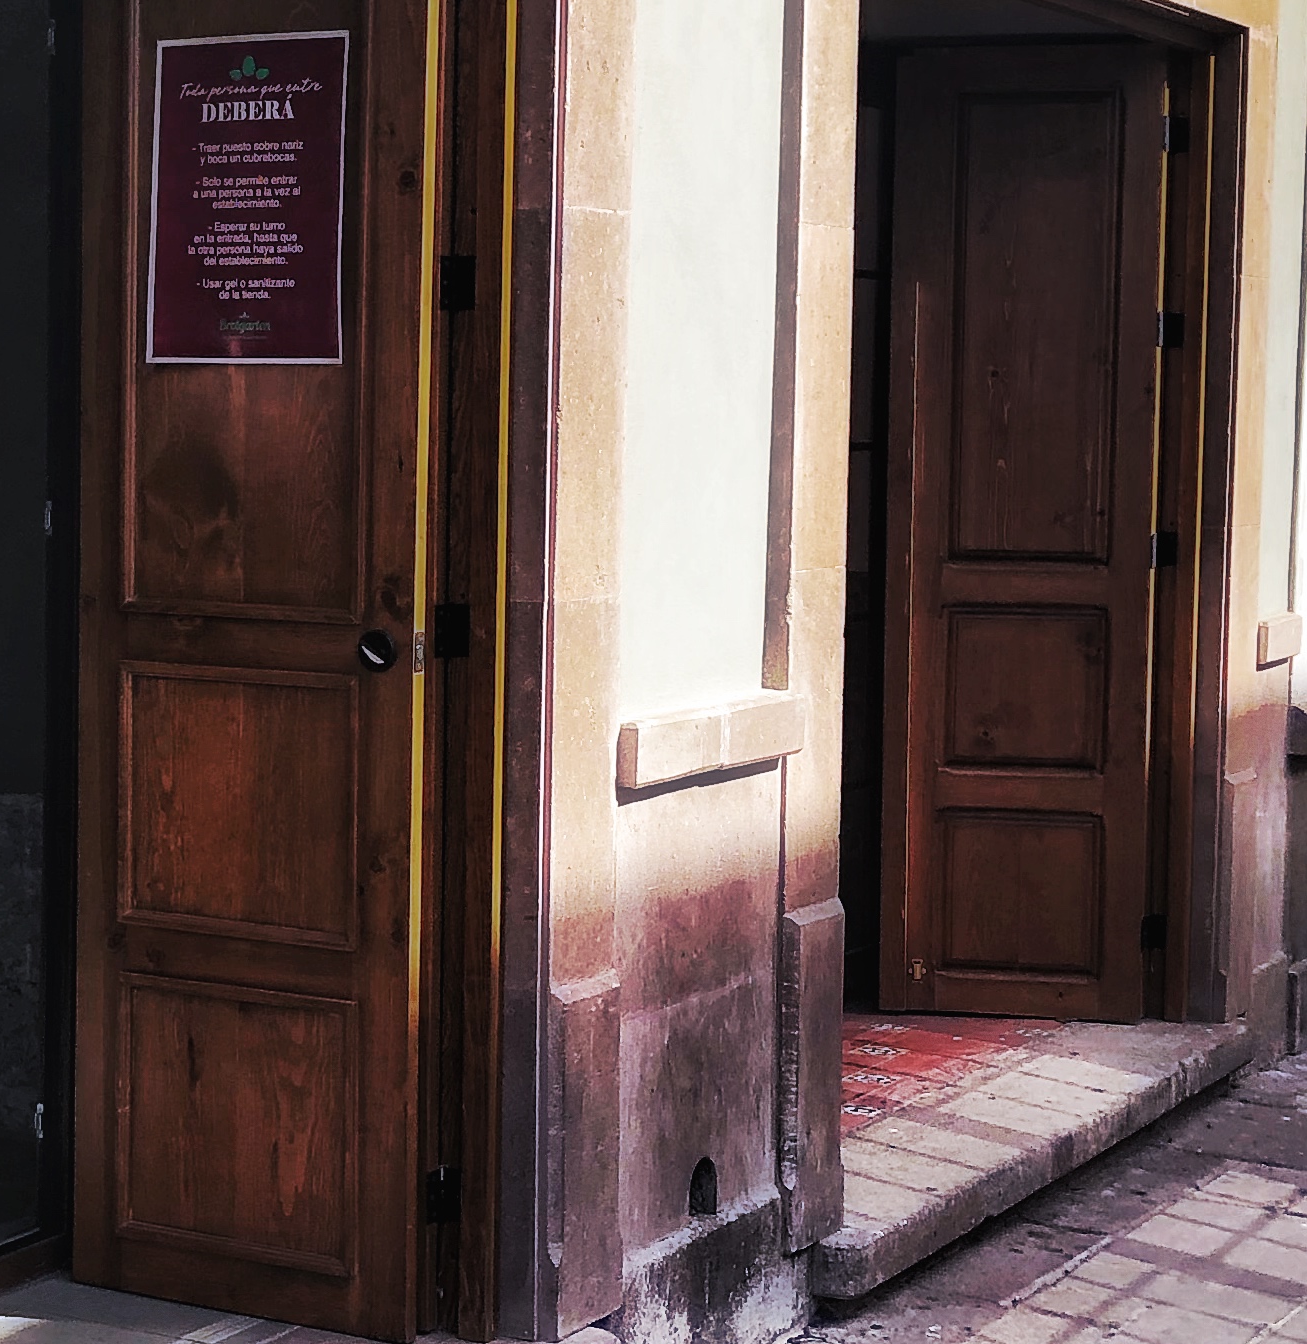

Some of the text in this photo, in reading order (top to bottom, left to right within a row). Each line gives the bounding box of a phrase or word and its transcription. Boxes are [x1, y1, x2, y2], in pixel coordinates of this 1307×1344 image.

[180, 77, 322, 102] Toda persona que entre
[200, 94, 294, 123] DEBERÁ
[198, 143, 220, 153] Traer
[223, 142, 252, 154] puesto
[254, 141, 279, 151] sobre
[282, 140, 304, 150] nariz
[208, 155, 227, 164] boca
[230, 155, 241, 163] un
[202, 176, 221, 187] Solo
[224, 178, 233, 186] se
[271, 175, 297, 185] entrar
[201, 190, 216, 198] una
[219, 189, 253, 200] persona
[264, 187, 272, 197] la
[274, 188, 290, 196] vez
[292, 186, 301, 195] al
[214, 221, 247, 233] Esperar
[250, 223, 260, 231] su
[263, 221, 286, 231] turno
[194, 233, 297, 243] en la entrada, hasta que
[188, 243, 304, 256] la otra persona haya salido
[203, 256, 216, 266] del
[202, 279, 222, 288] Usar
[225, 279, 238, 290] gel
[219, 290, 230, 299] de
[232, 290, 240, 299] la
